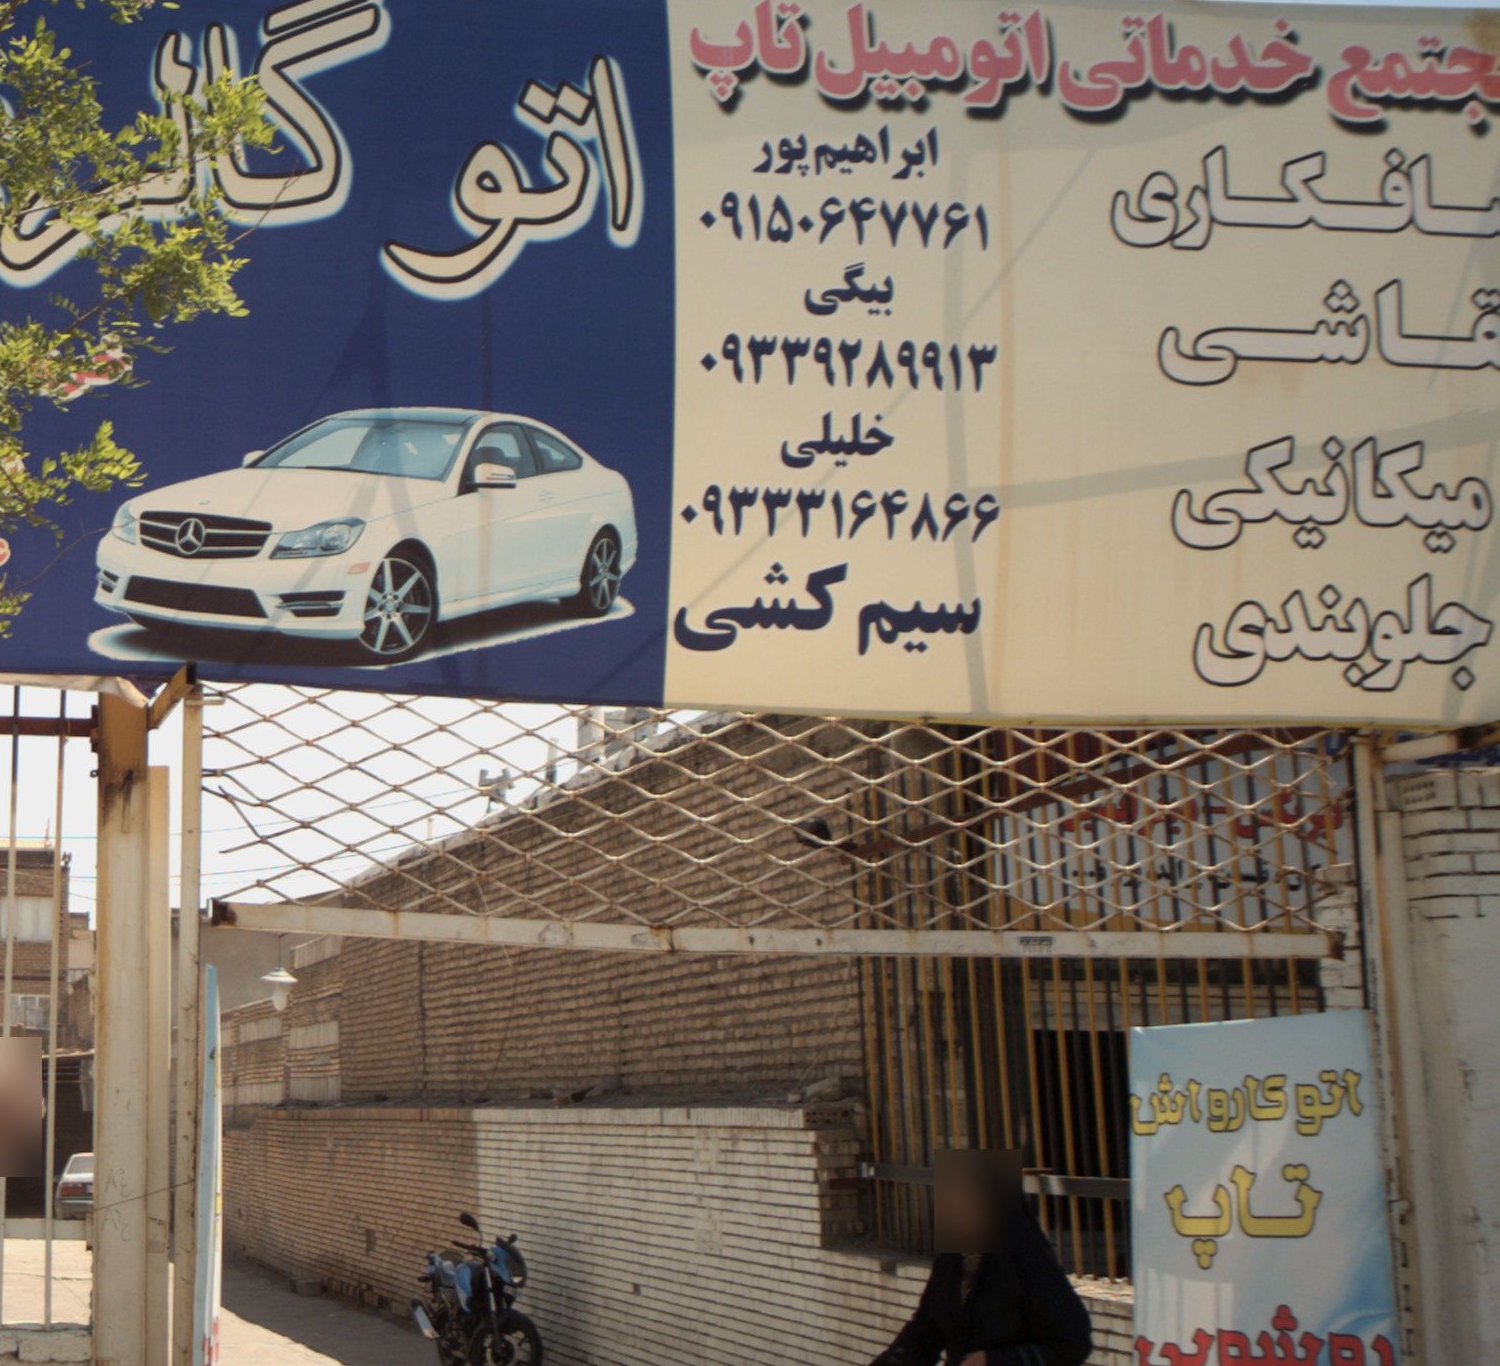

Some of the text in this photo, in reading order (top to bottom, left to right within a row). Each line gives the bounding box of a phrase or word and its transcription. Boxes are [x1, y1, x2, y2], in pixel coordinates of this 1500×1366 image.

[813, 3, 1053, 109] اتومبیل
[1057, 15, 1314, 111] خدماتی
[384, 53, 640, 297] اتو
[700, 191, 989, 251] ۰۹۱۵۰۶۴۷۷۶۱
[803, 261, 895, 317] بیگی
[1158, 278, 1500, 386] قاشی
[700, 333, 997, 393] ۰۹۳۳۹۲۸۹۹۱۳
[781, 411, 895, 469] خلیلی
[680, 485, 999, 543] ۰۹۳۳۳۱۶۴۸۶۶
[1171, 435, 1493, 554] میکانیکی
[673, 560, 981, 656] سیم کشی
[1192, 572, 1493, 692] جلوبندی
[1130, 1069, 1363, 1136] اتو کارواش
[1164, 1163, 1323, 1270] تاپ
